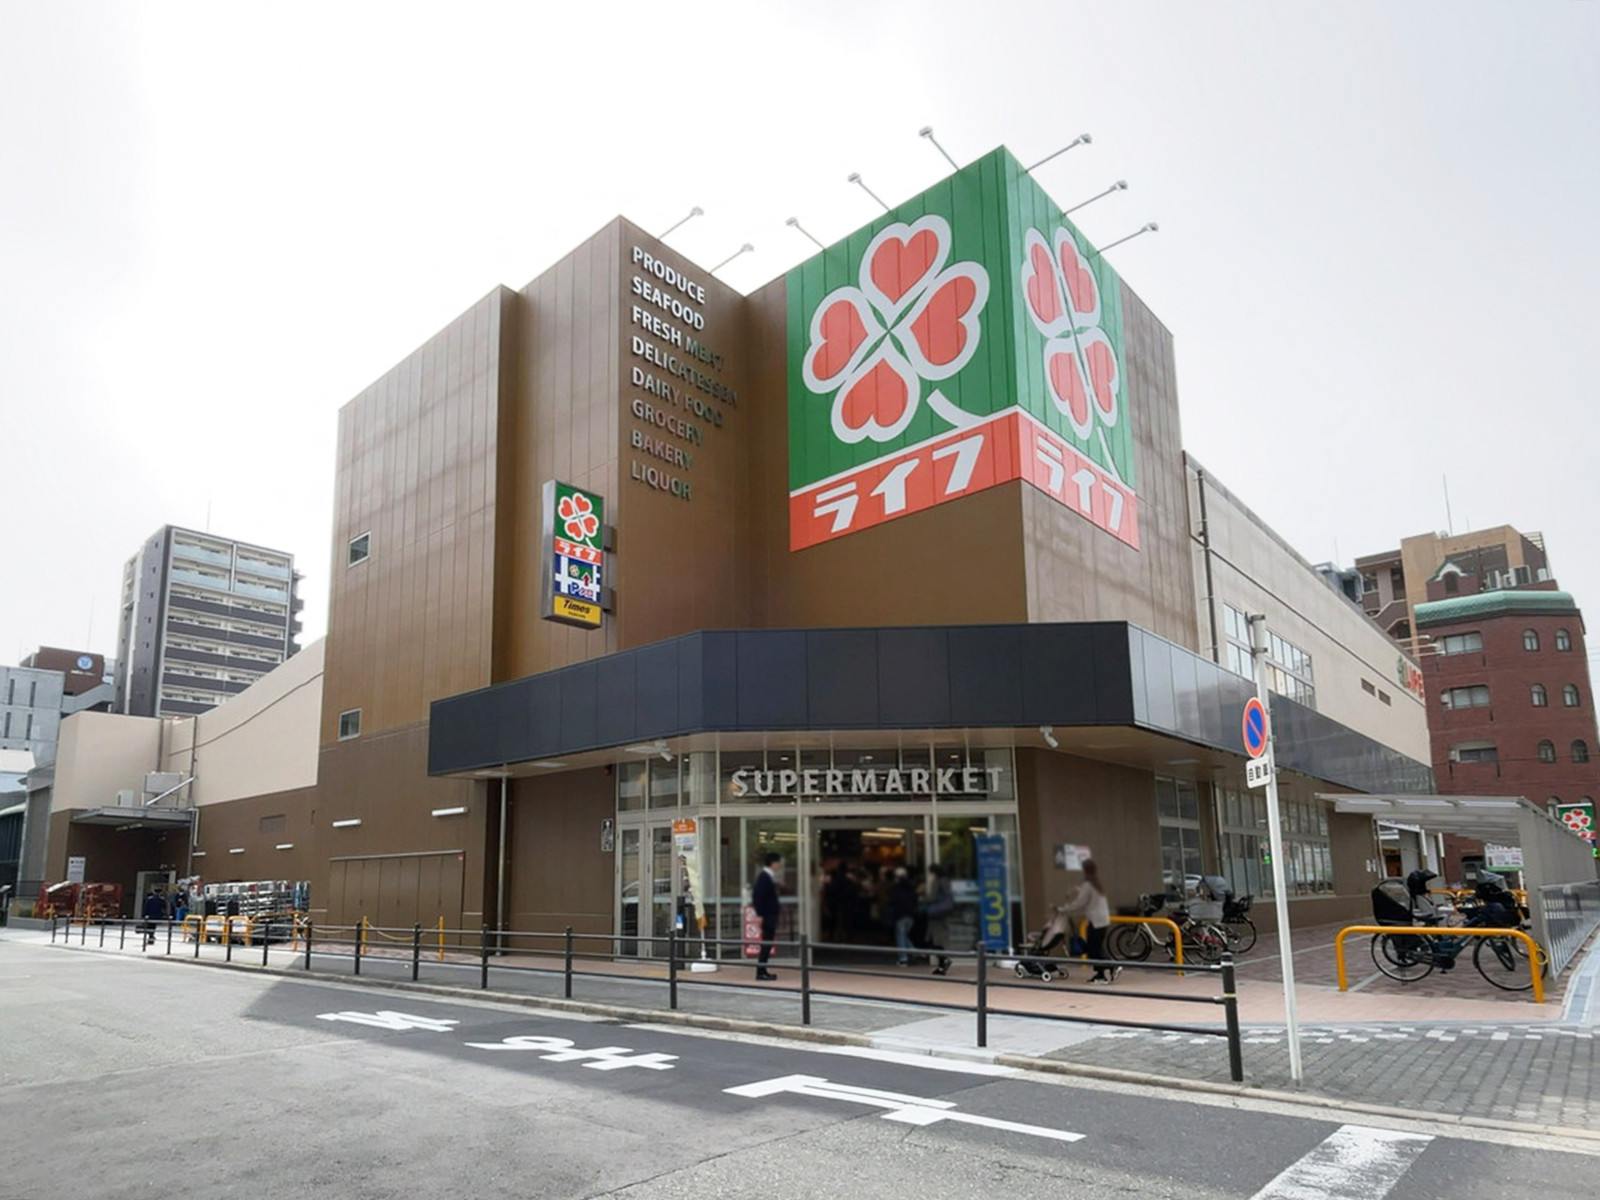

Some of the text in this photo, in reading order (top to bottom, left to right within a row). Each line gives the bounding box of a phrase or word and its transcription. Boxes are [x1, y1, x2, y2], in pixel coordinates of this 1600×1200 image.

[632, 245, 706, 305] PRODUCE
[632, 275, 705, 331] SEAFOOD
[632, 305, 724, 373] FRESH MEAT
[632, 335, 738, 407] DELICATESSEN
[632, 367, 723, 428] DAIRY FOOD
[631, 399, 703, 447] GROCERY
[631, 429, 693, 471] BAKERY
[631, 461, 692, 501] LIQUOR
[813, 434, 985, 534] ライフ
[1036, 435, 1124, 533] ライフ
[558, 540, 597, 561] ライフ
[563, 599, 591, 614] Times
[731, 766, 1004, 797] SUPERMARKET
